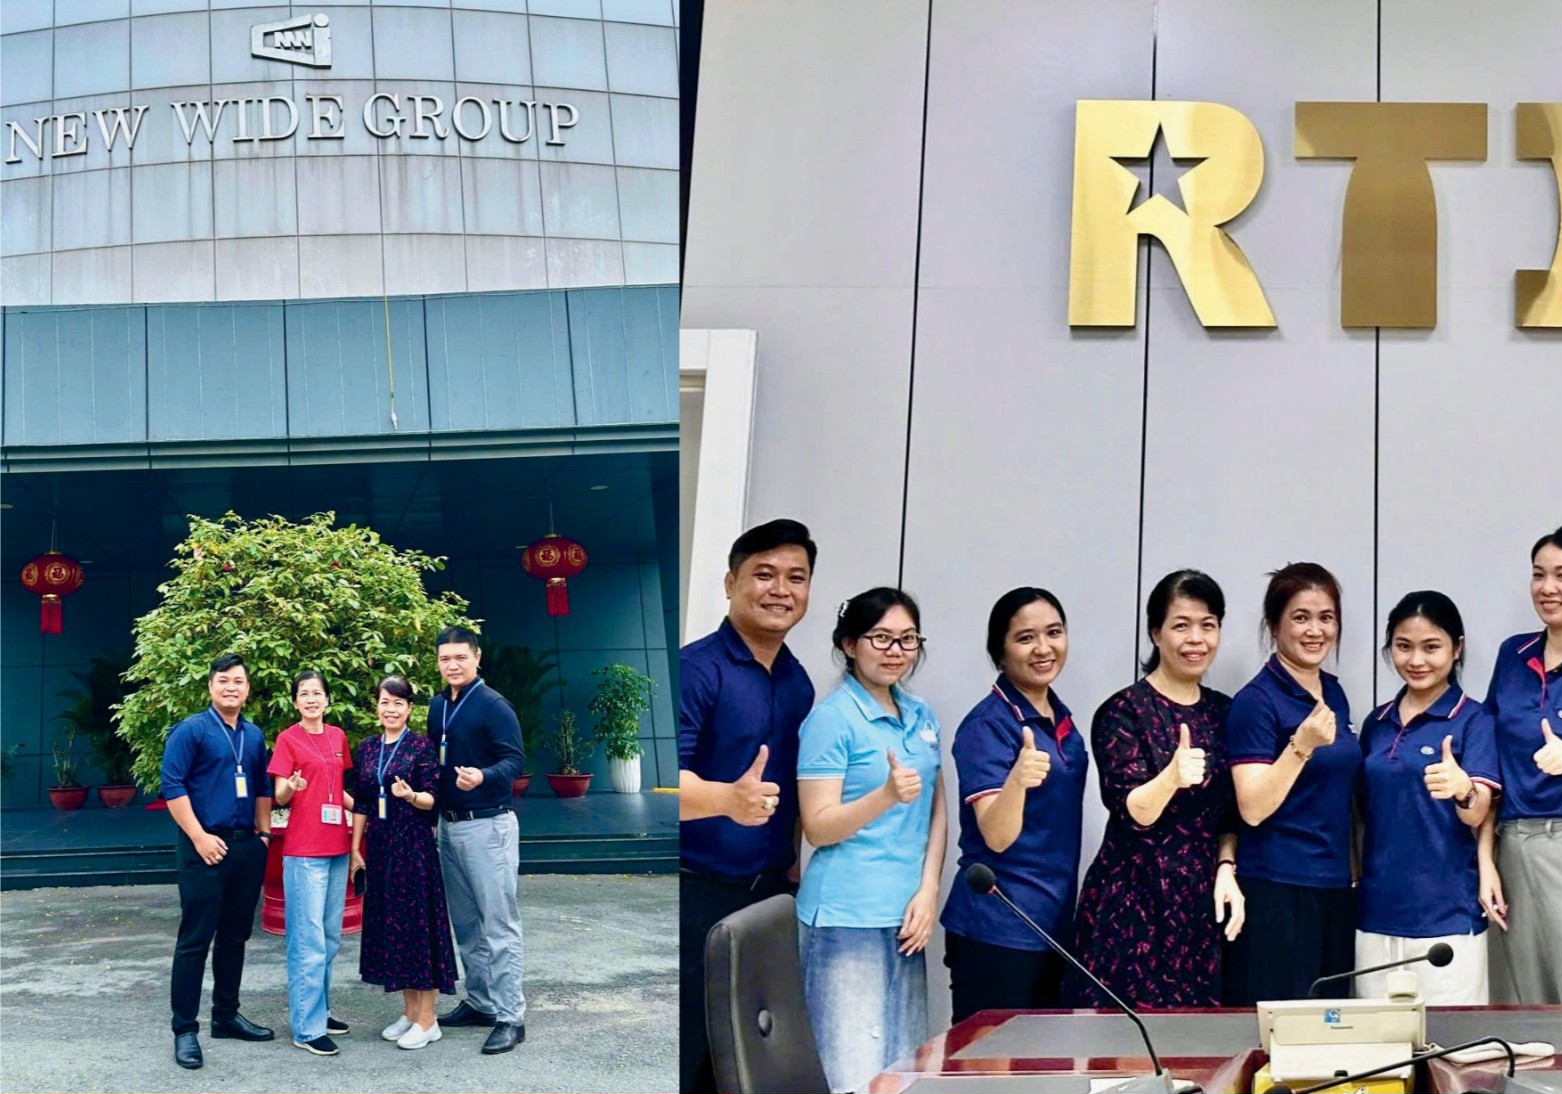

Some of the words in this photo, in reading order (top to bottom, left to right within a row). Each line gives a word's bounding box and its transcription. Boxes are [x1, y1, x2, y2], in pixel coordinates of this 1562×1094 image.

[4, 104, 150, 164] NEW
[170, 94, 346, 145] WIDE
[362, 92, 580, 147] GROUP
